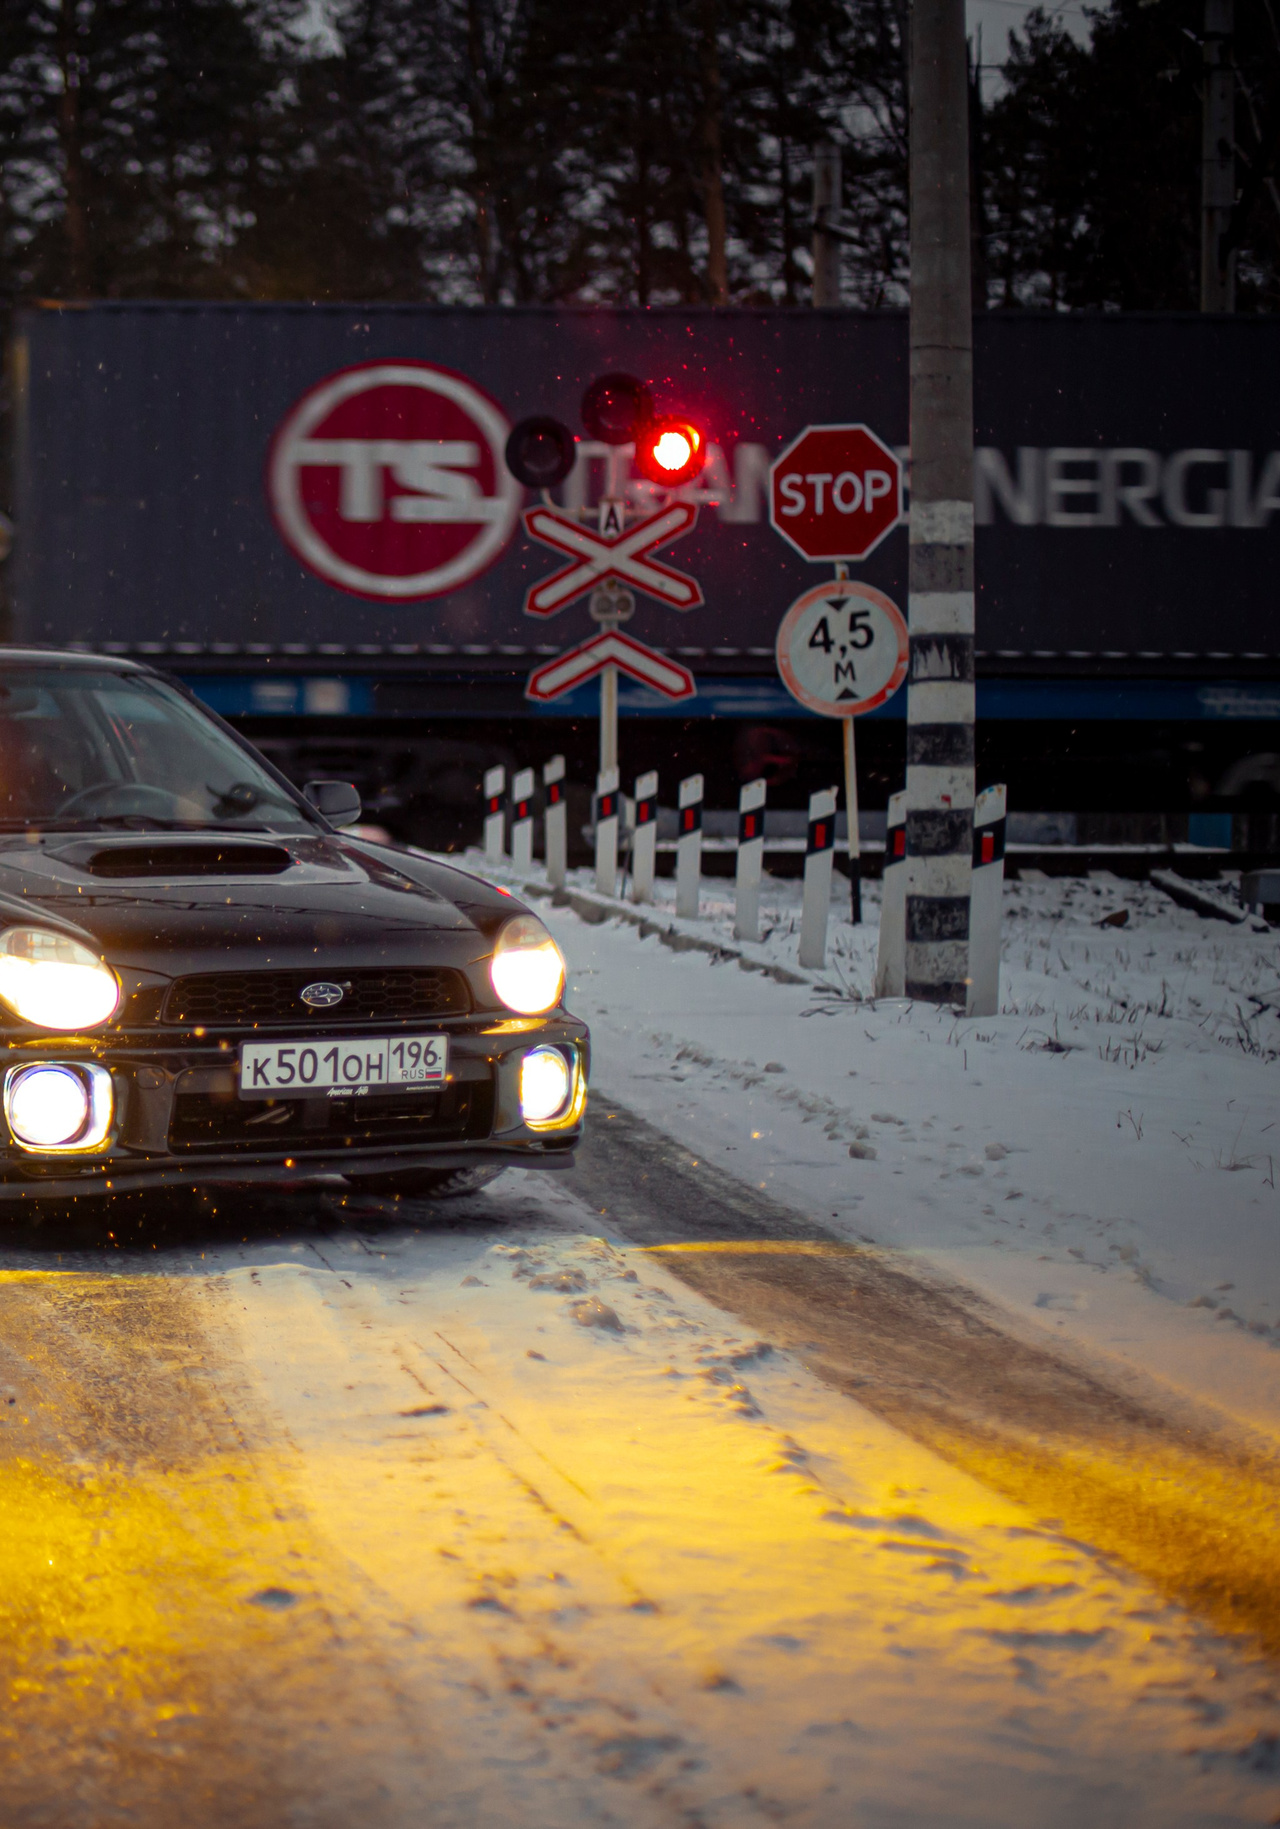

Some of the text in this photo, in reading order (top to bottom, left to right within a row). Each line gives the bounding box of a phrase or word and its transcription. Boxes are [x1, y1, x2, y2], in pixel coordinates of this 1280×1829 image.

[293, 440, 503, 523] TS
[779, 469, 892, 517] STOP
[808, 610, 874, 659] 4,5
[391, 1040, 439, 1069] 196
[401, 1068, 425, 1080] RUS
